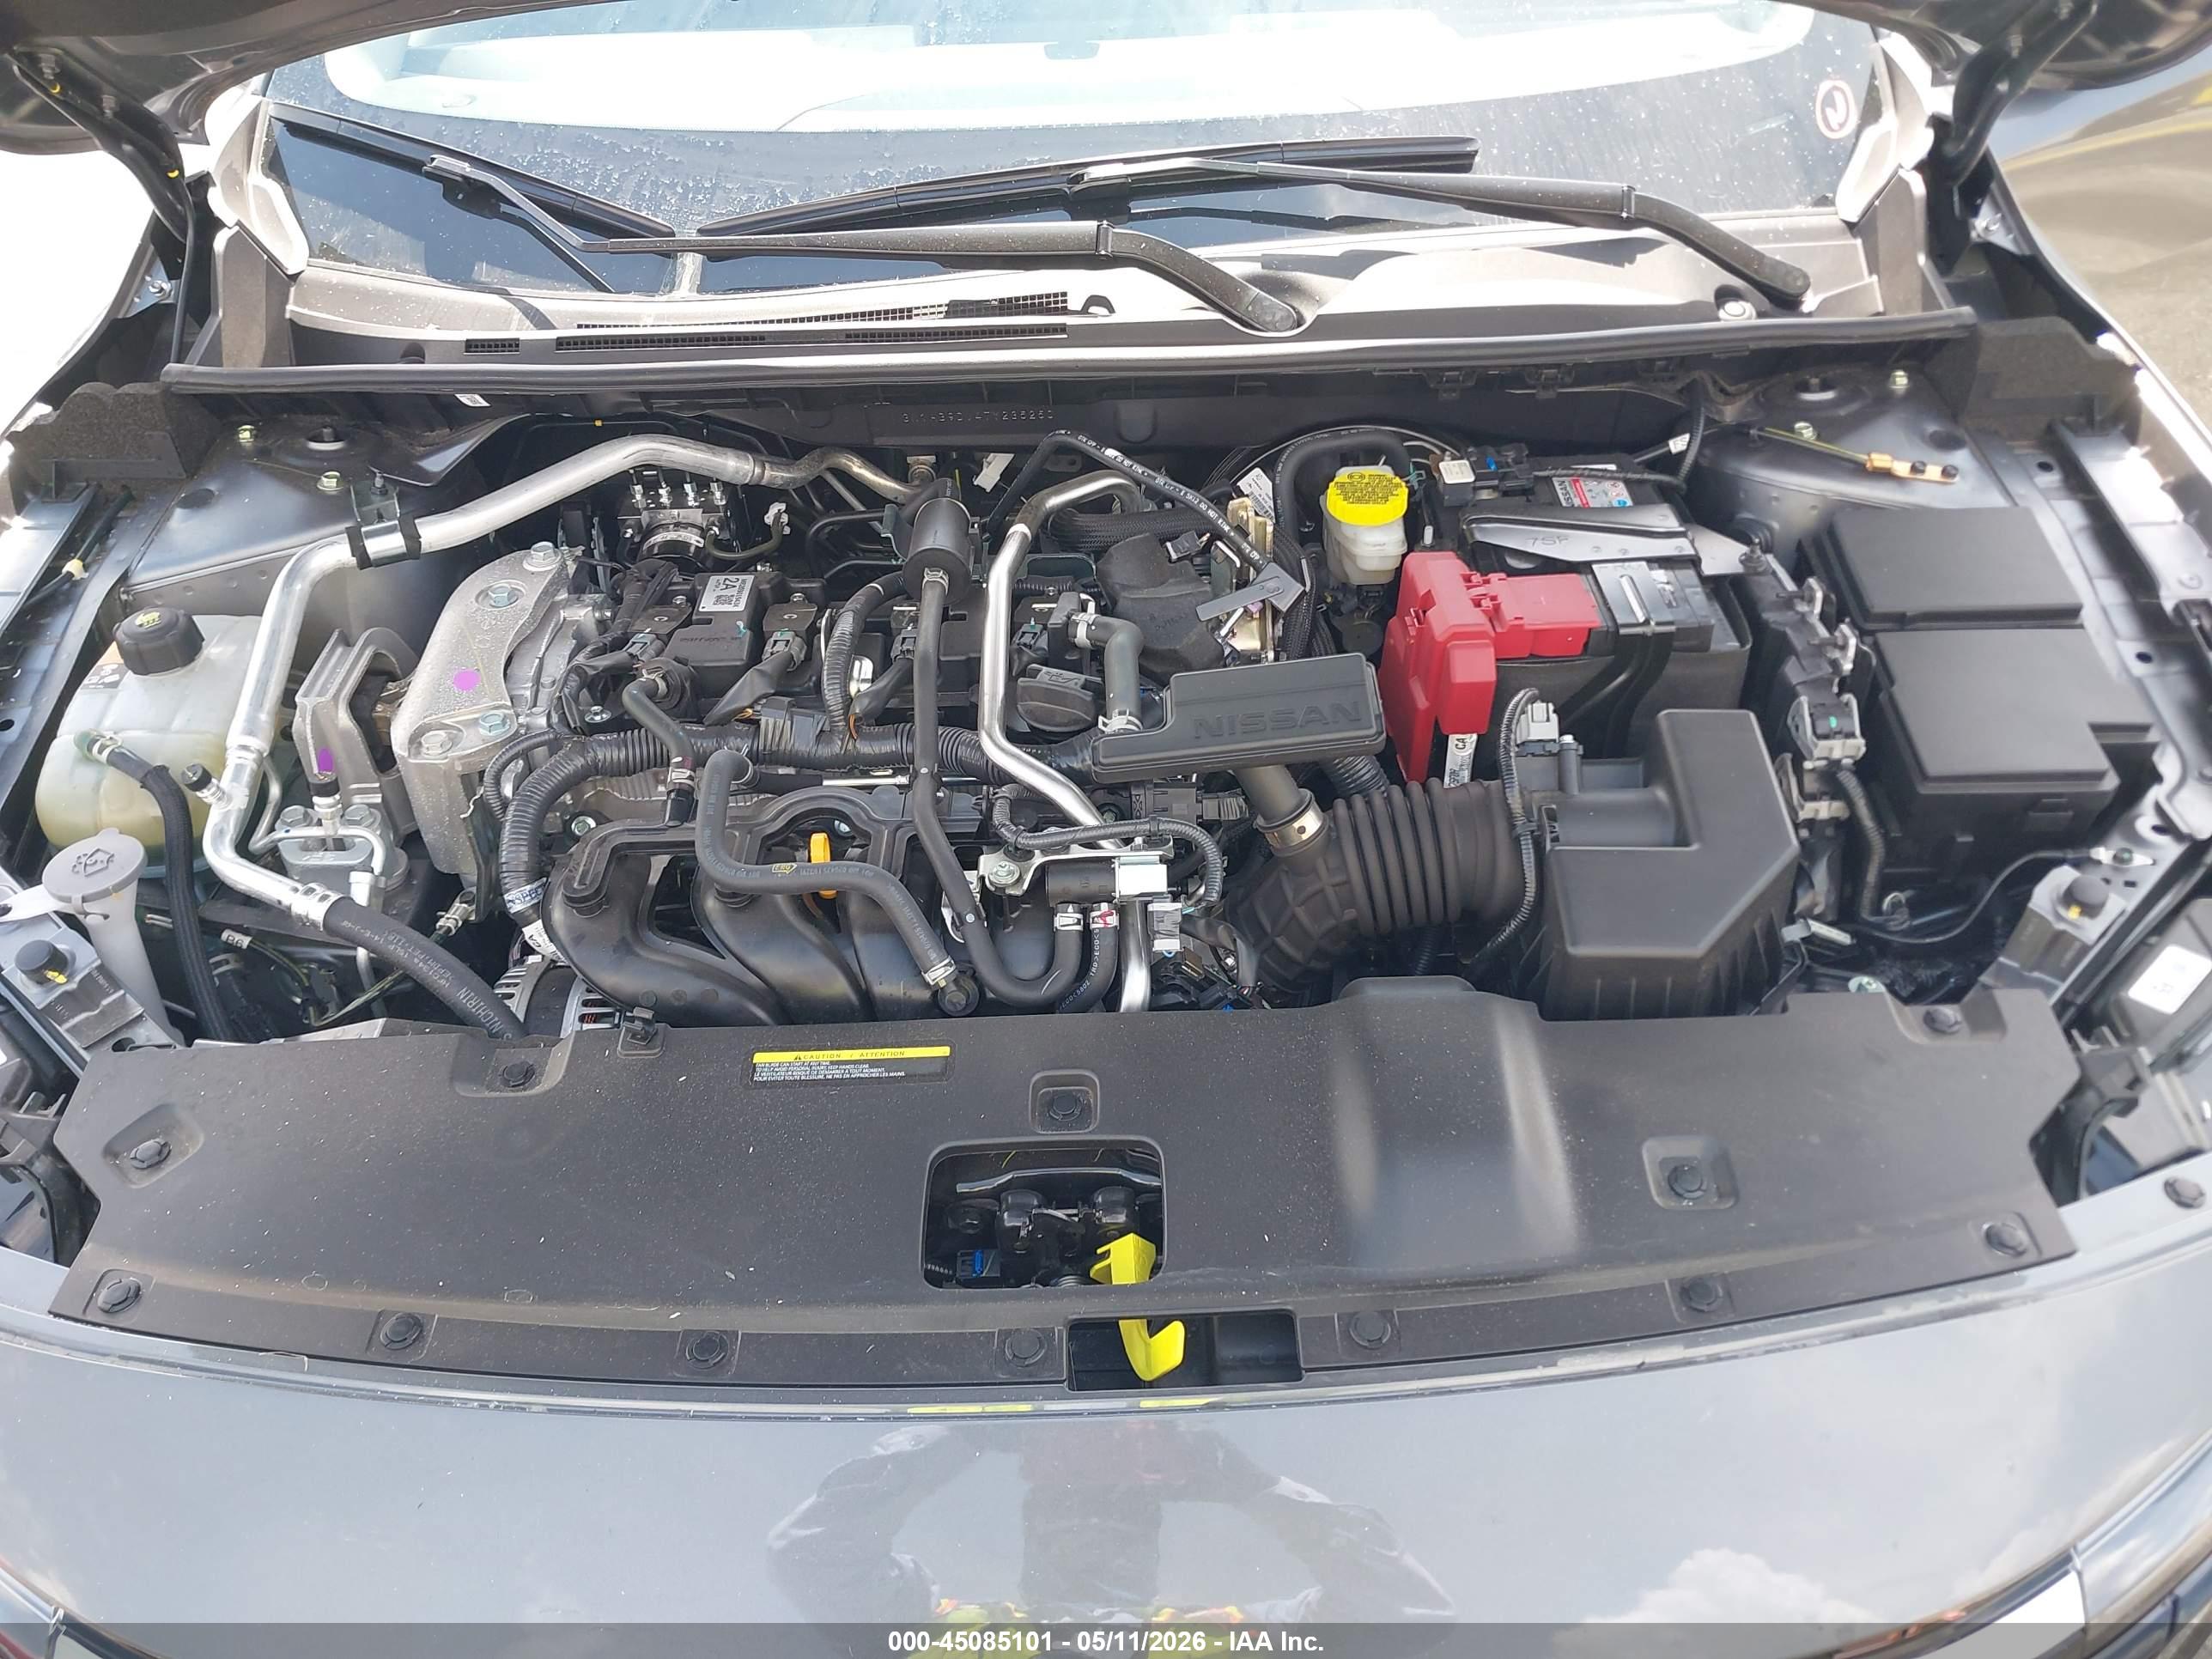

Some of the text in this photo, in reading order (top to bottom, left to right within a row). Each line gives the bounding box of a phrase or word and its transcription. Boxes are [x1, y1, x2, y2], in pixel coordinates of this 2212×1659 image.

[1207, 509, 1218, 520] NOT
[1218, 519, 1231, 533] KINK
[720, 577, 740, 591] 2A
[1193, 701, 1362, 739] NISSAN
[455, 987, 504, 1035] NICHIRIN
